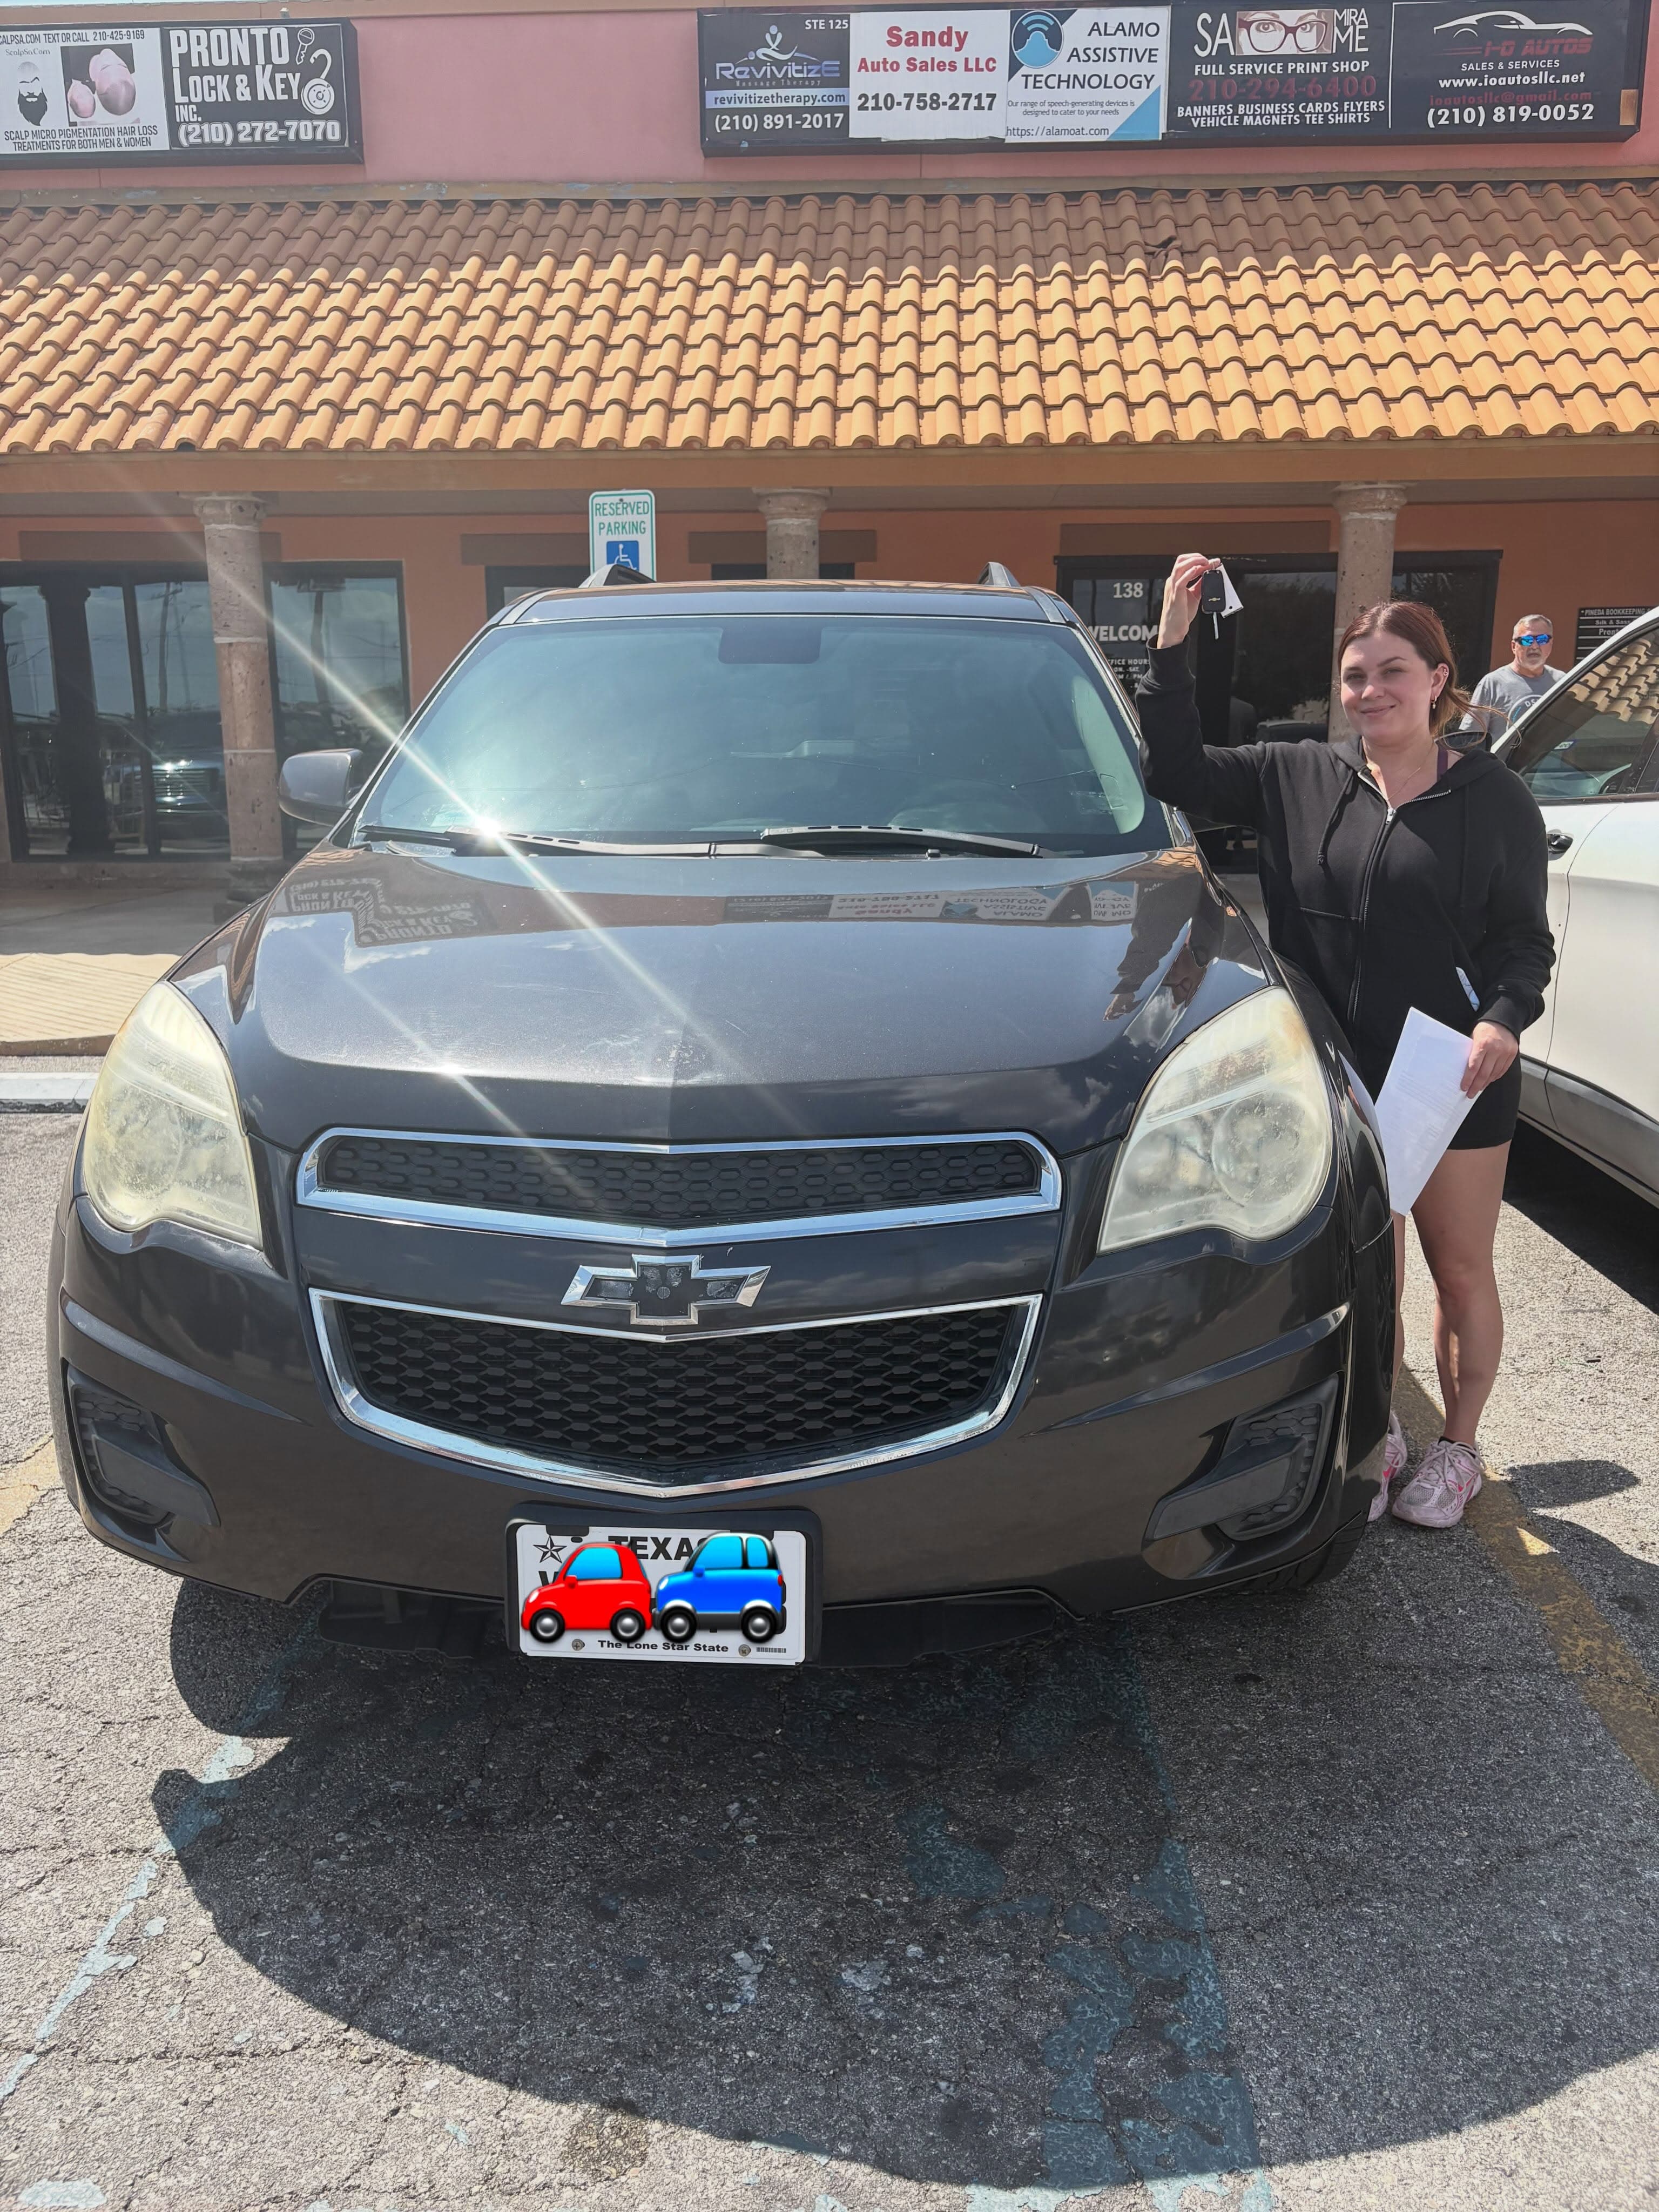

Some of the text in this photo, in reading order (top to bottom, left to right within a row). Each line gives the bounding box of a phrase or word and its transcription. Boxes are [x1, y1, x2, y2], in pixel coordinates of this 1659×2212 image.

[805, 19, 849, 30] STE 125
[1334, 8, 1368, 26] MIRA
[43, 33, 60, 43] TEXT
[62, 33, 71, 43] OR
[72, 32, 90, 42] CALL
[93, 30, 145, 41] 210-425-9169
[1088, 22, 1160, 37] ALAMO
[1193, 12, 1235, 57] SA
[886, 25, 969, 52] Sandy
[1333, 25, 1368, 53] ME
[1521, 37, 1593, 56] AUTOS
[170, 27, 289, 67] PRONTO
[1067, 48, 1158, 63] ASSISTIVE
[858, 57, 997, 73] Auto Sales LLC
[1195, 60, 1370, 76] FULL SERVICE PRINT SHOP
[1461, 59, 1560, 71] SALES & SERVICES
[1021, 73, 1155, 90] TECHNOLOGY
[1439, 71, 1585, 87] www.ioautosllc.net
[236, 74, 251, 101] &
[1189, 75, 1377, 101] 210-294-6400
[714, 92, 846, 105] revivitizetherapy.com
[858, 92, 997, 111] 210-758-2717
[1047, 100, 1104, 108] speech-generating
[1429, 90, 1592, 106] ioautosllc@gmail.com
[176, 105, 201, 122] INC.
[1177, 100, 1385, 117] BANNERS BUSINESS CARDS FLYERS
[1427, 104, 1594, 128] (210) 819-0052
[715, 113, 844, 133] (210) 891-2017
[1191, 112, 1371, 127] VEHICLE MAGNETS TEE SHIRTS
[4, 125, 158, 141] SCALP MICRO PIGMENTATION HAIR LOSS
[178, 120, 341, 147] (210) 272-7070
[1006, 126, 1109, 138] https://alamoat.com
[12, 137, 151, 152] TREATMENTS FOR BOTH MEN & WOMEN
[595, 501, 650, 517] RESERVED
[598, 521, 646, 536] PARKING
[1113, 583, 1143, 598] 138
[1088, 625, 1158, 642] WELCOM
[608, 1536, 708, 1560] TEXA
[598, 1640, 729, 1652] The Lone Star State
